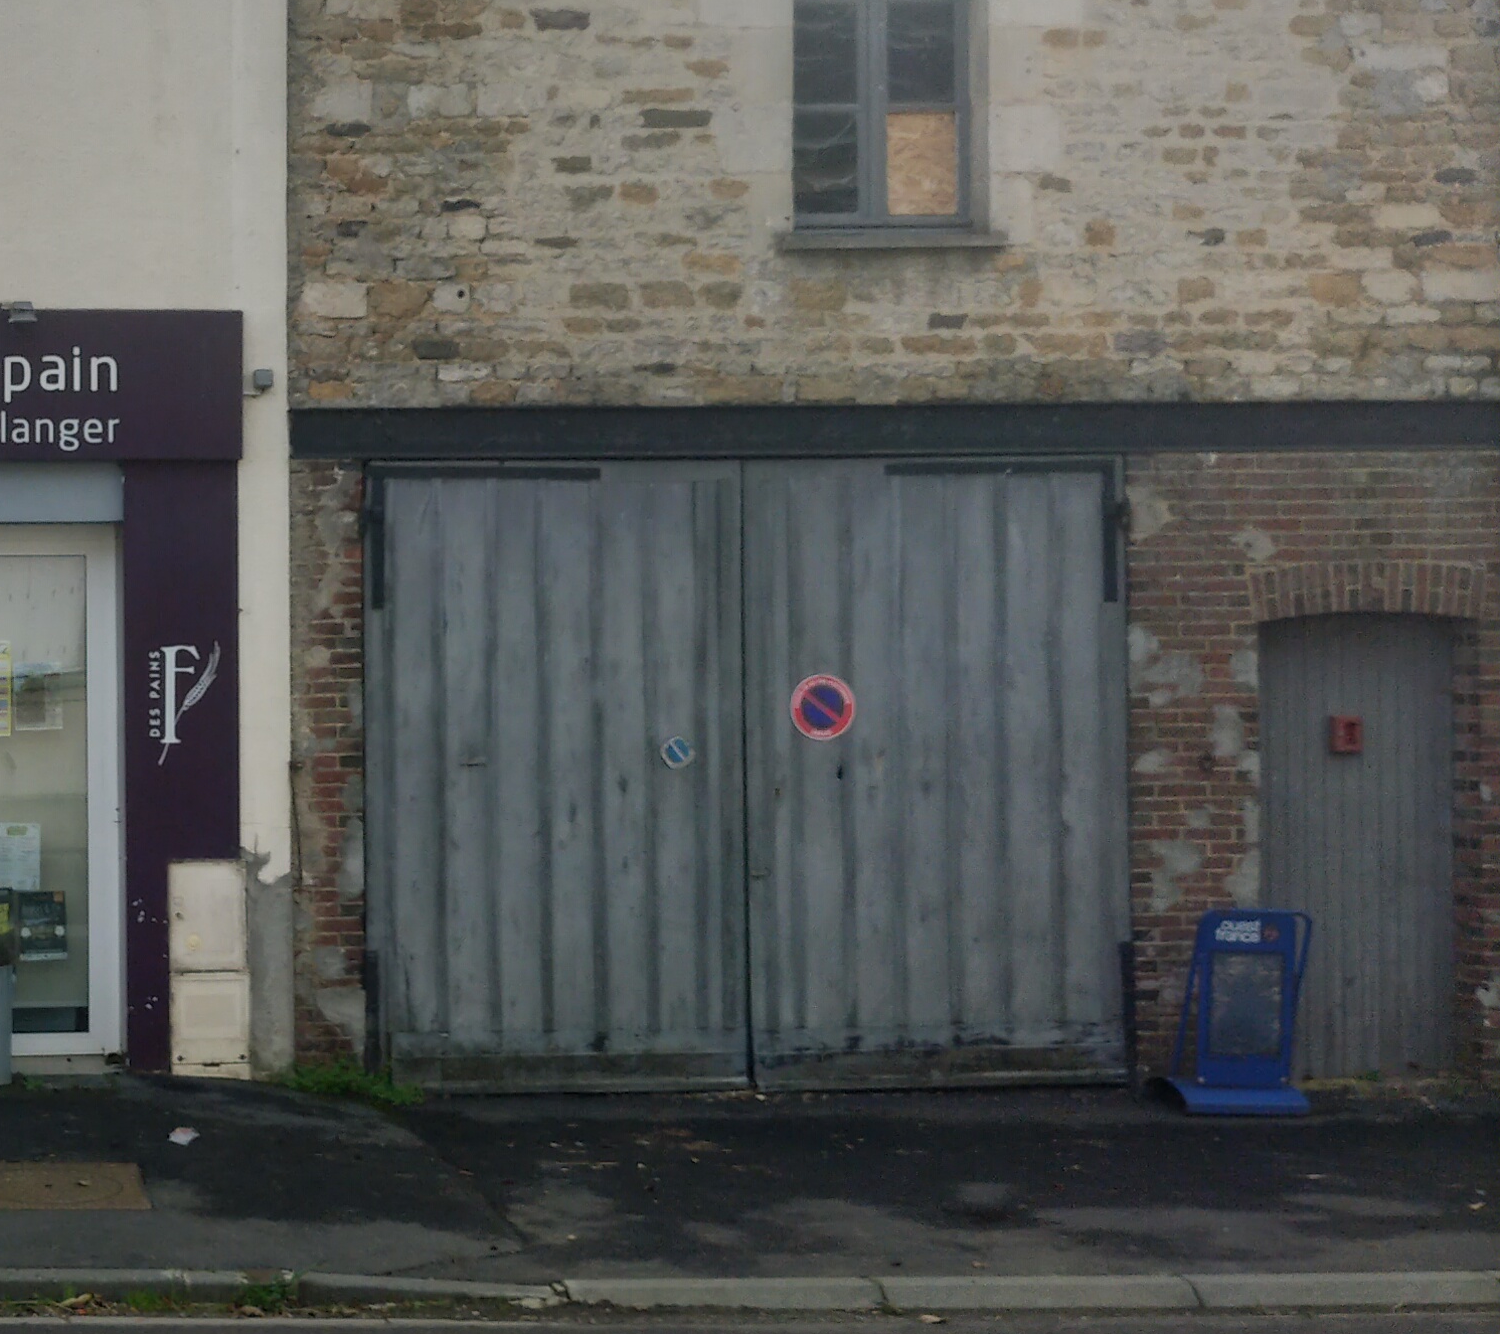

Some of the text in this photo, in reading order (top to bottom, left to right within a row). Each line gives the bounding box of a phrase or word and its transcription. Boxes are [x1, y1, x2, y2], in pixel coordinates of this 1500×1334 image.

[2, 345, 119, 404] pain
[148, 650, 161, 738] DES PAINS
